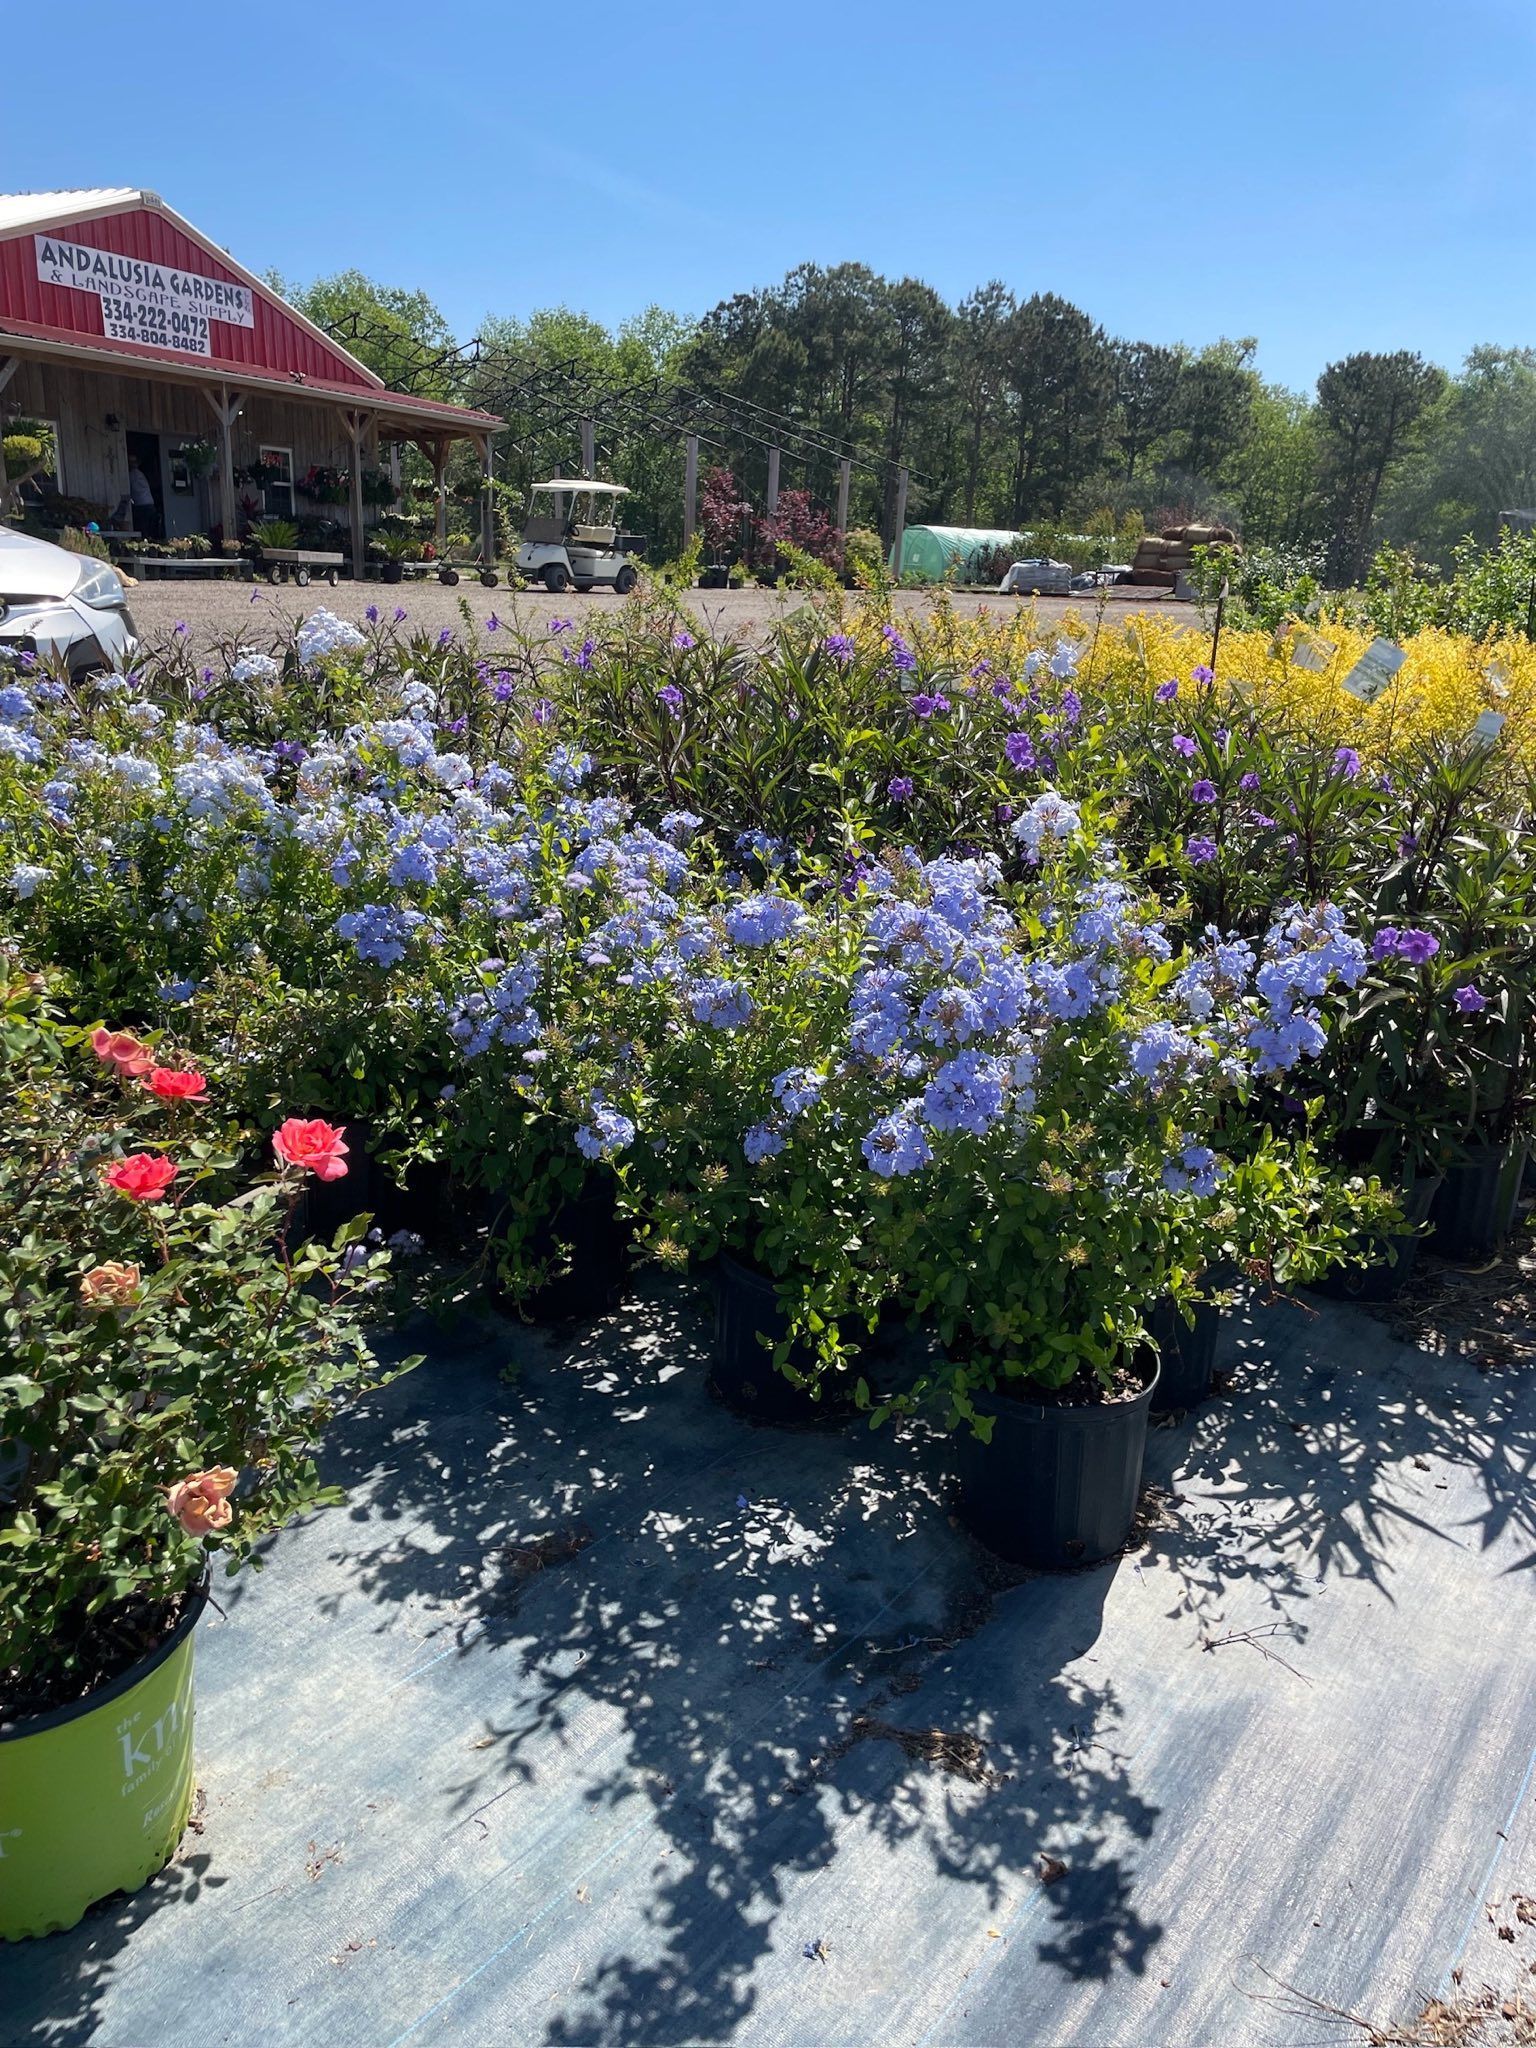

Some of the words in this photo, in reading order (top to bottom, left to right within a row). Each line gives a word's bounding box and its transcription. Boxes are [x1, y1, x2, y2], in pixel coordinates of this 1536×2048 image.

[41, 241, 166, 292] ANDALUSIA
[170, 272, 243, 310] GARDENS
[51, 269, 62, 284] &
[72, 274, 182, 309] LANDSCAPE
[188, 301, 245, 324] SUPPLY
[103, 297, 208, 339] 334-222-0472
[109, 323, 206, 354] 334-804-8482
[115, 1711, 142, 1735] the
[121, 1757, 162, 1798] family
